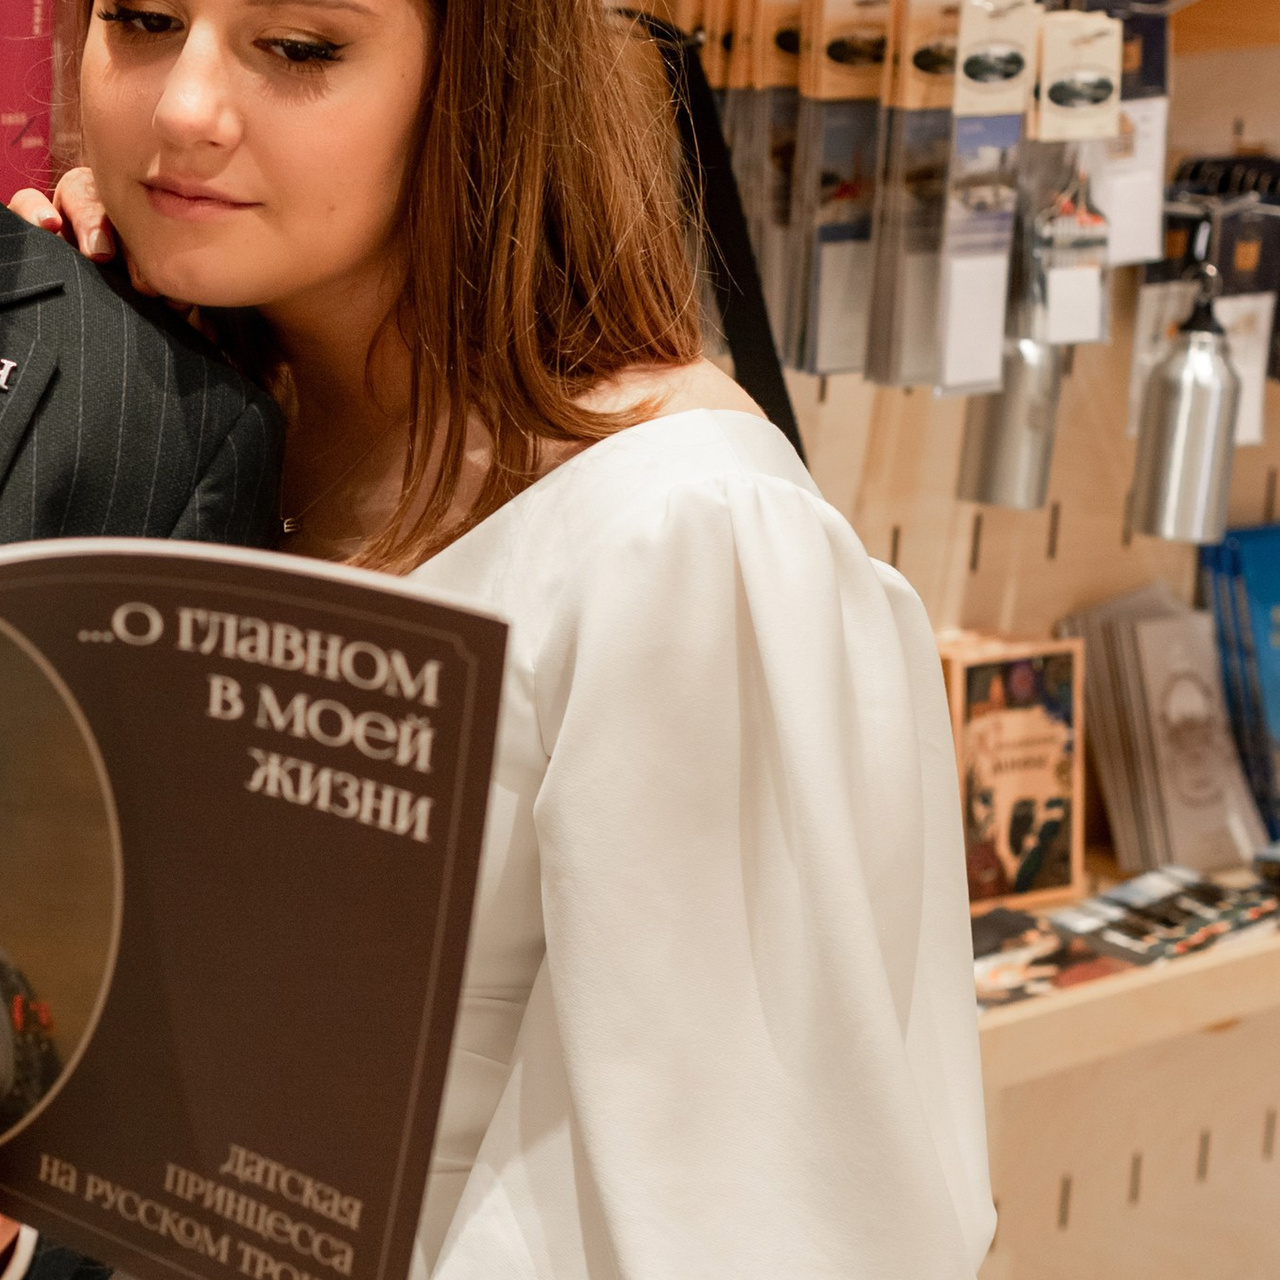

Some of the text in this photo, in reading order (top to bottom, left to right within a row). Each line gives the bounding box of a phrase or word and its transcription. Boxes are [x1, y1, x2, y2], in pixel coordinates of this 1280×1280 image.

[38, 1154, 78, 1194] на
[85, 1174, 230, 1266] русском
[164, 1162, 355, 1277] принцесса
[221, 1143, 364, 1231] датская
